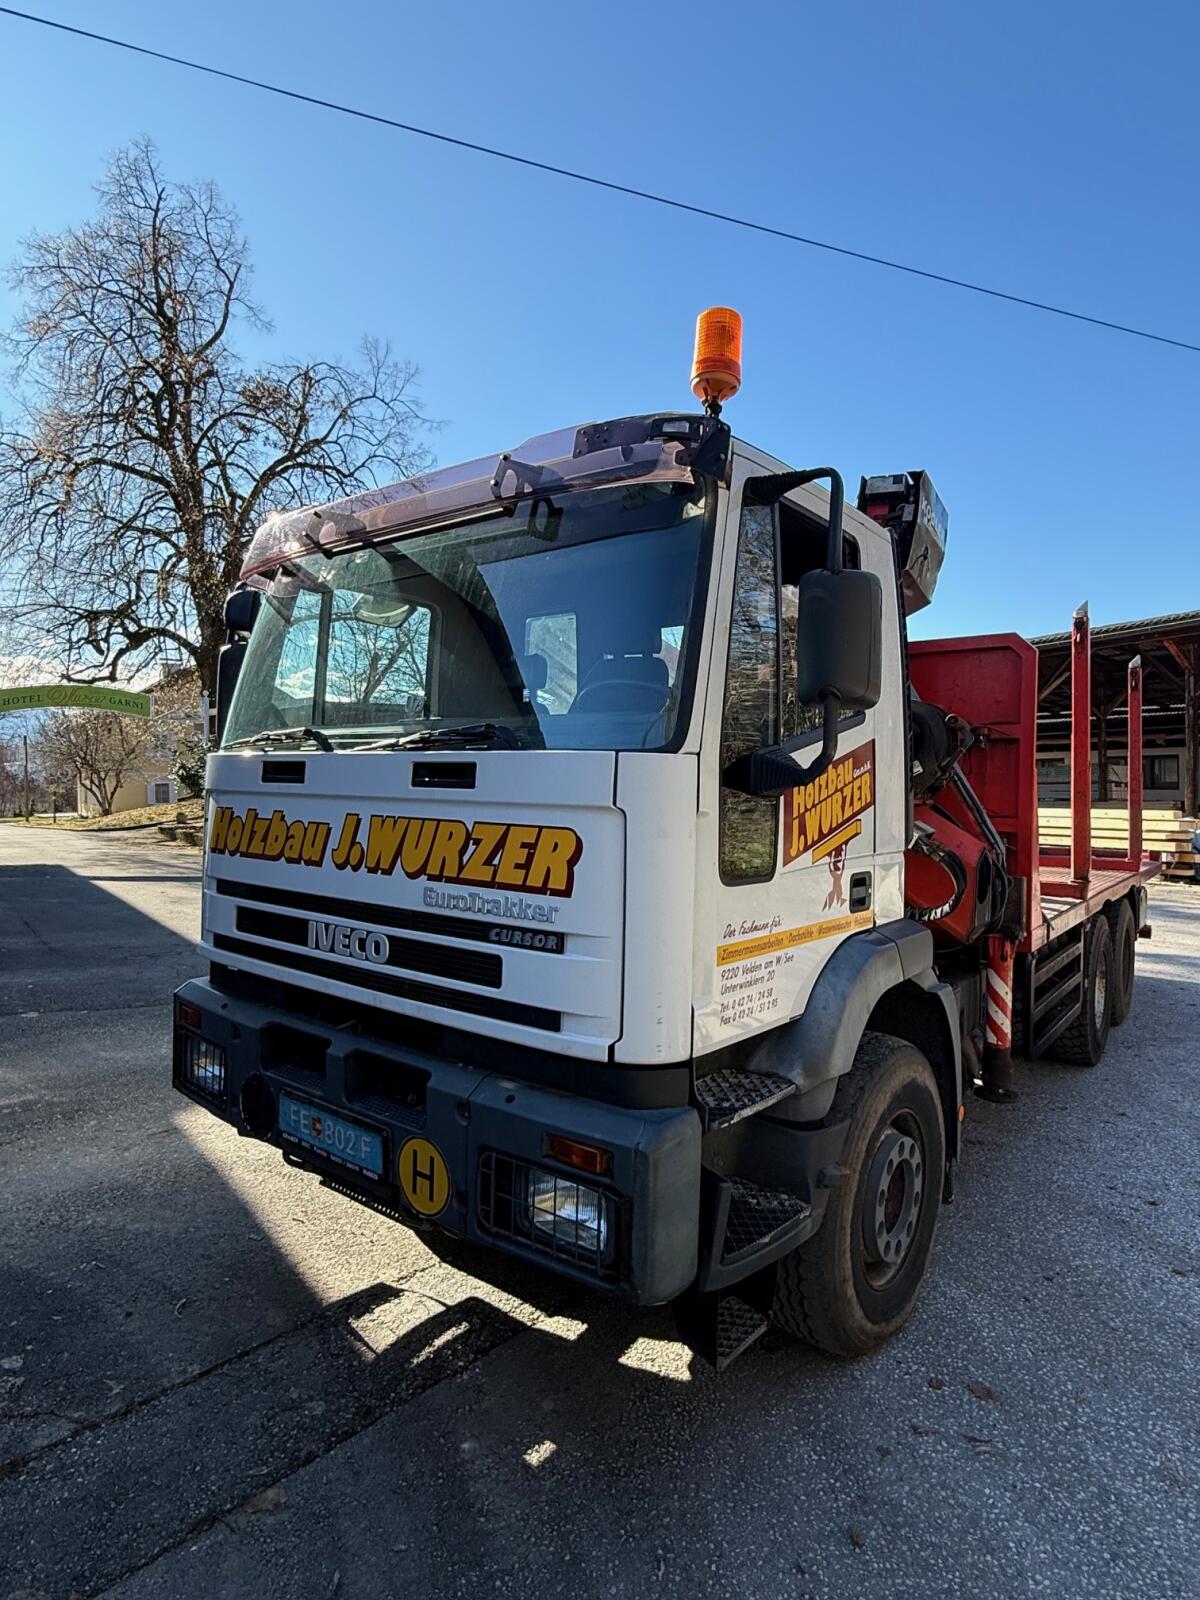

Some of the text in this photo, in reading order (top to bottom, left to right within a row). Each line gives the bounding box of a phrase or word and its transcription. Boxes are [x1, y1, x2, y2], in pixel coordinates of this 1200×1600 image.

[3, 694, 42, 706] HOTEL
[109, 697, 144, 710] GARNI
[793, 758, 853, 819] Holzbau
[210, 806, 332, 868] Holzbau
[423, 886, 561, 924] EuroTrakker
[307, 920, 390, 964] IVECO
[488, 927, 558, 950] CURSOR
[723, 923, 736, 939] Der
[738, 919, 770, 936] Fachmann
[720, 969, 775, 996] Unterwinklern 20
[721, 966, 739, 981] 9220
[742, 961, 762, 976] Velden
[764, 960, 774, 970] am
[737, 996, 745, 1008] 42
[746, 994, 753, 1005] 74
[758, 990, 765, 1001] 24
[766, 987, 773, 998] 58
[720, 1015, 731, 1027] Fax
[738, 1009, 745, 1020] 42
[759, 1001, 766, 1013] 51
[290, 1104, 372, 1160] FE 802 F
[412, 1148, 435, 1204] H
